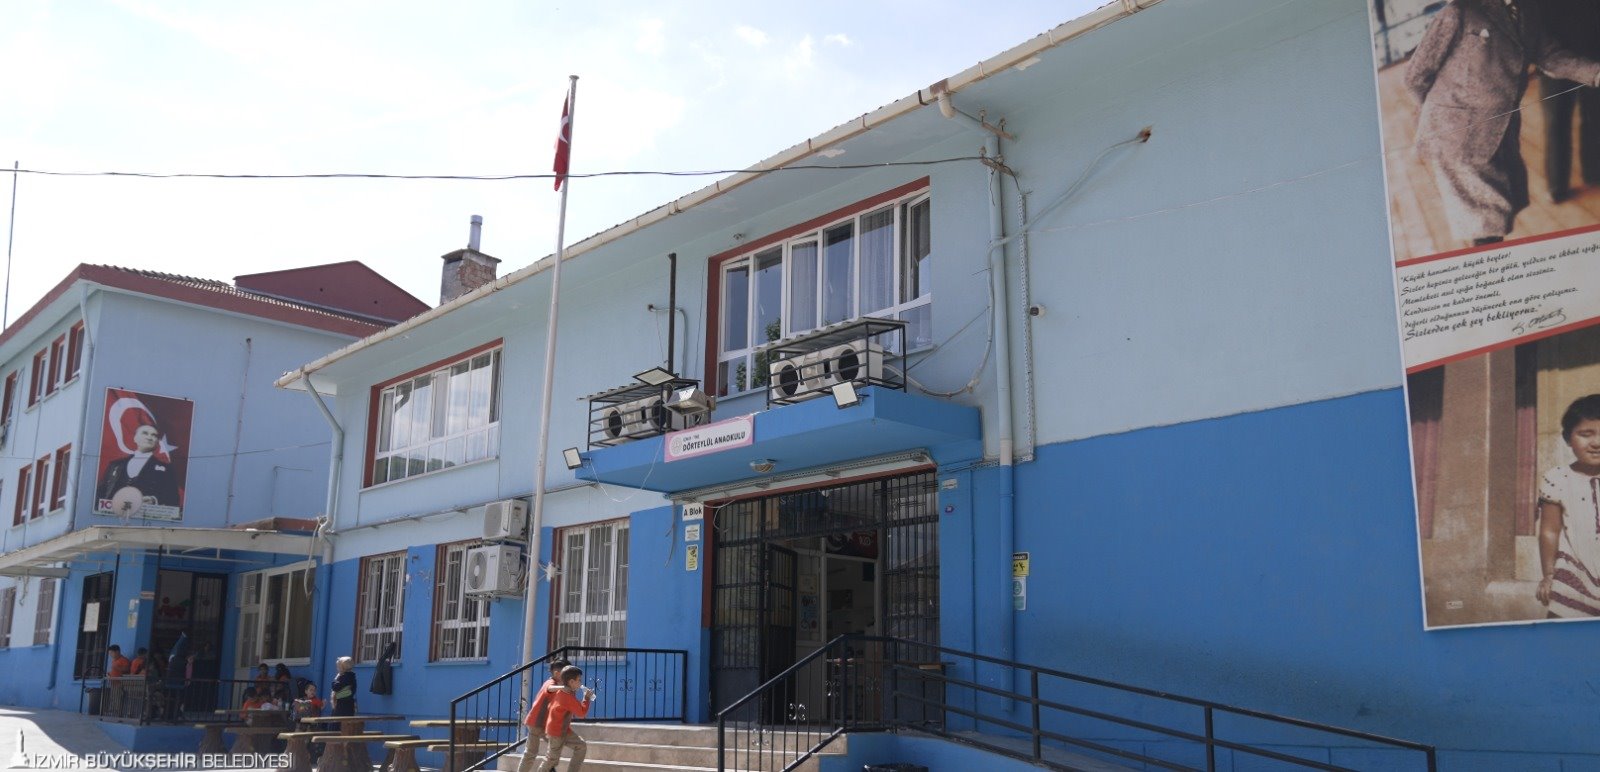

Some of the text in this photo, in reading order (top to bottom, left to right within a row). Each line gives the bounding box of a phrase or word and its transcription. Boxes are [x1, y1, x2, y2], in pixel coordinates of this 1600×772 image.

[1463, 257, 1485, 268] küçük
[1486, 251, 1511, 263] beyler!
[1400, 285, 1425, 296] Sizler
[1426, 279, 1452, 289] hepiniz
[1401, 291, 1439, 307] Memleketi
[1475, 276, 1505, 289] boğacak
[1507, 273, 1524, 282] olan
[1452, 297, 1473, 306] kadar
[1524, 294, 1541, 304] göre
[1404, 324, 1450, 341] Sizlerden
[1452, 319, 1468, 331] çok
[1469, 317, 1484, 328] şey
[683, 438, 713, 452] DÖRTEYLÜL
[715, 431, 746, 444] ANAOKULU
[690, 507, 702, 515] Blok
